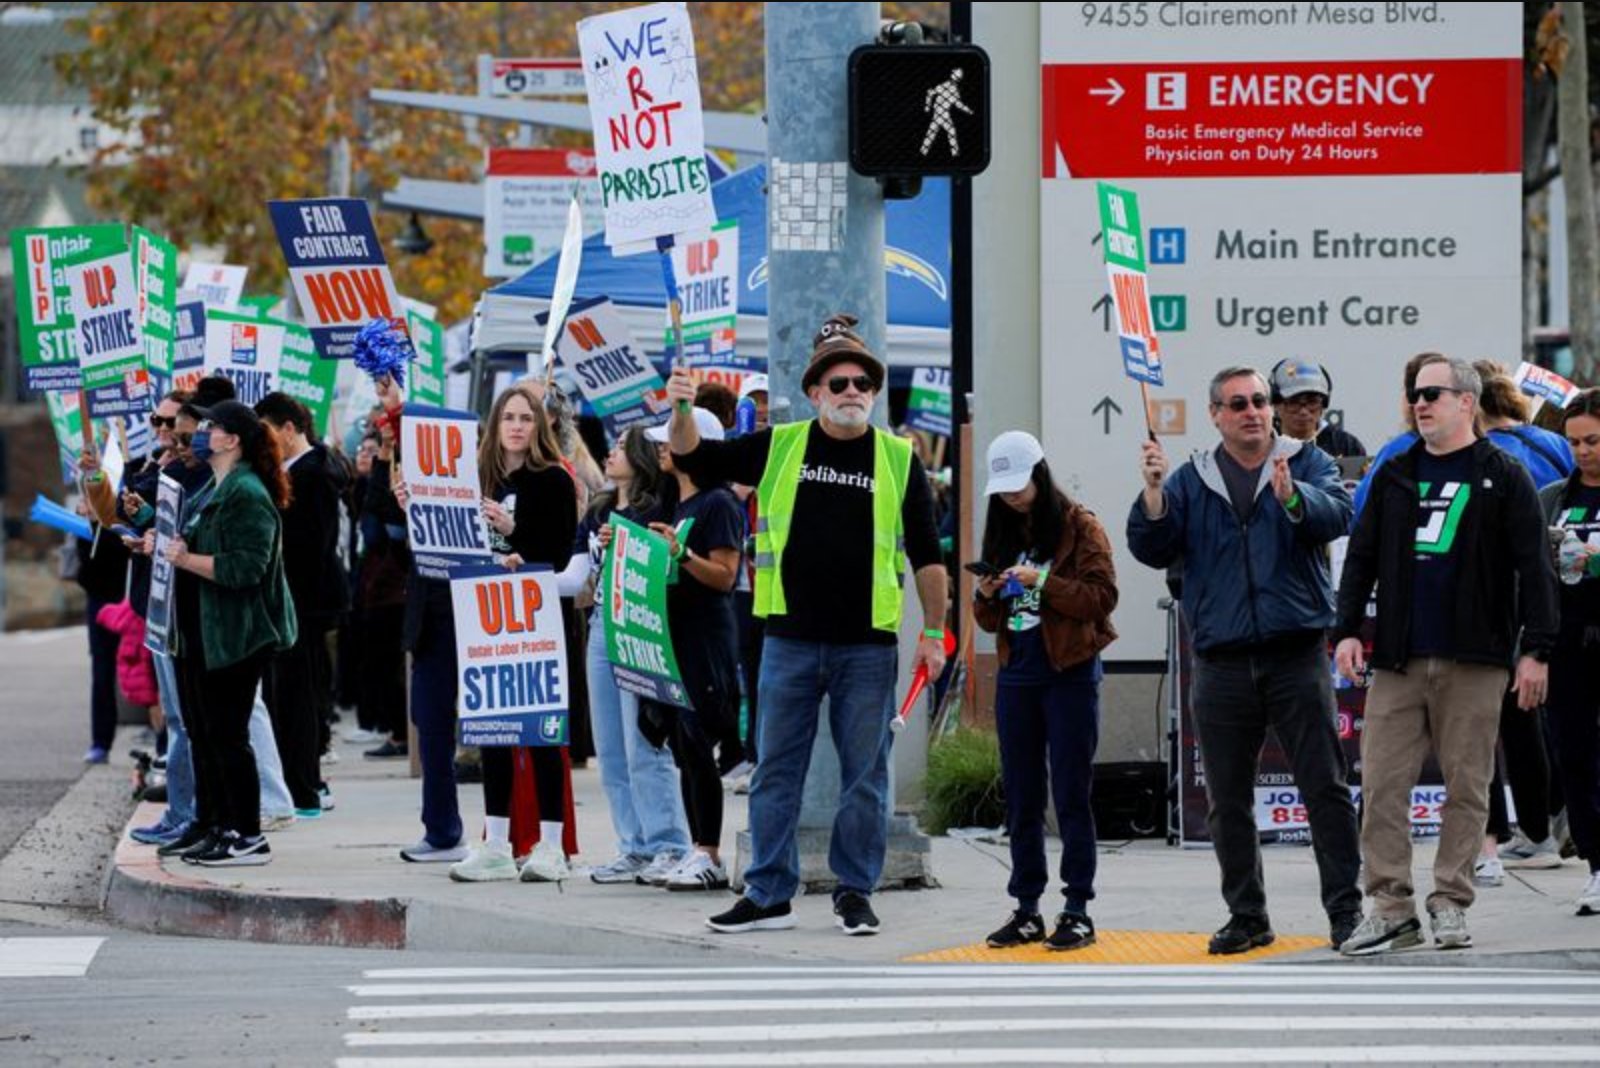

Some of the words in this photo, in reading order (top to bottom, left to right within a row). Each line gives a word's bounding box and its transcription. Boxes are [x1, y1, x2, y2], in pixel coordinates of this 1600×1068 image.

[1081, 3, 1149, 27] 9455
[1159, 2, 1298, 26] Clairemont
[1307, 2, 1375, 25] Mesa
[1385, 2, 1446, 24] Blvd.
[605, 18, 667, 62] WE
[627, 66, 653, 110] R
[1209, 73, 1434, 106] EMERGENCY
[609, 102, 682, 152] NOT
[1145, 124, 1188, 139] Basic
[1194, 123, 1285, 143] Emergency
[1291, 121, 1357, 138] Medical
[1363, 120, 1423, 137] Service
[1145, 144, 1223, 165] Physician
[1230, 149, 1251, 160] on
[1257, 145, 1295, 165] Duty
[1301, 144, 1323, 160] 24
[1329, 144, 1378, 160] Hours
[601, 156, 708, 207] PARASITES
[300, 206, 347, 234] FAIR
[293, 235, 370, 258] CONTRACT
[687, 239, 719, 276] ULP
[1158, 233, 1179, 259] H
[1216, 229, 1298, 260] Main
[1313, 229, 1457, 260] Entrance
[83, 265, 117, 309] ULP
[304, 267, 393, 325] NOW
[677, 276, 729, 314] TRIKE
[81, 309, 137, 356] STRIKE
[1158, 300, 1179, 328] U
[1216, 298, 1328, 335] Urgent
[1341, 296, 1420, 326] Care
[575, 345, 645, 389] STRIKE
[416, 423, 463, 478] ULP
[410, 503, 485, 549] STRIKE
[475, 579, 543, 636] ULP
[615, 631, 671, 677] STRIKE
[463, 659, 561, 711] STRIKE
